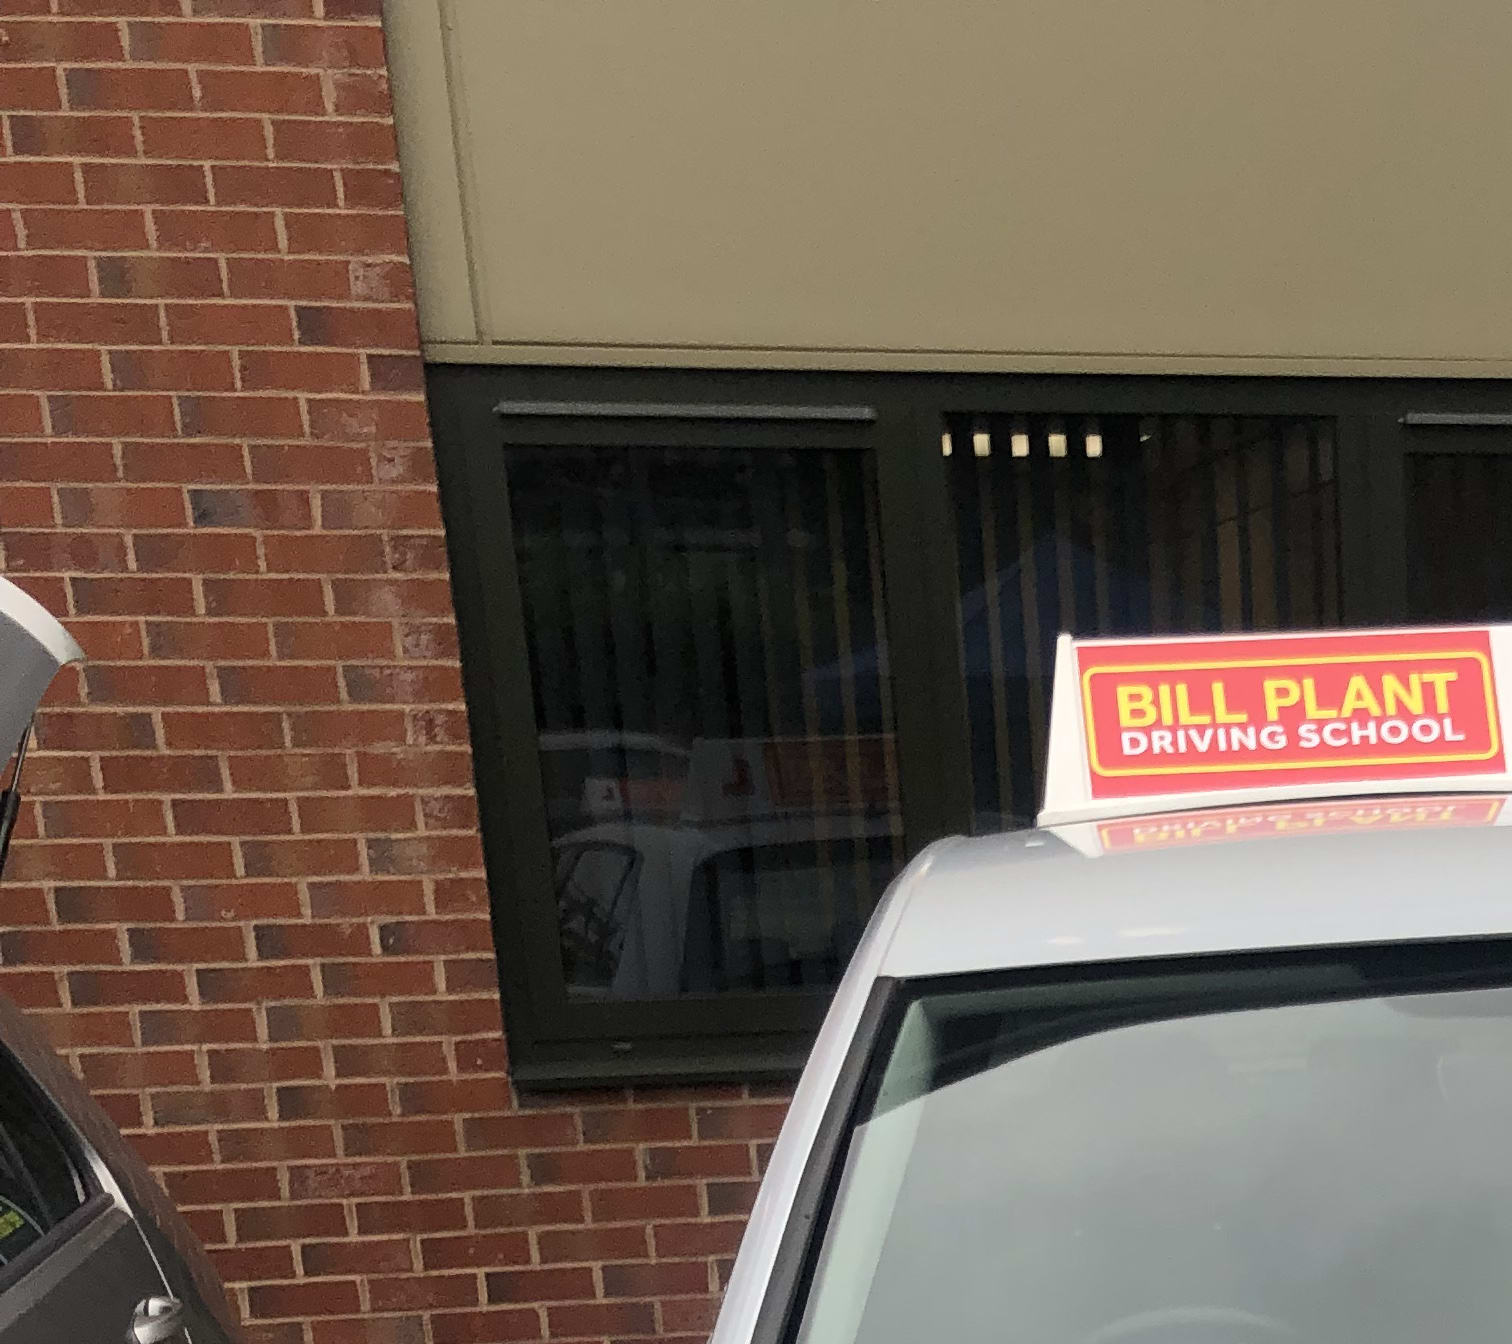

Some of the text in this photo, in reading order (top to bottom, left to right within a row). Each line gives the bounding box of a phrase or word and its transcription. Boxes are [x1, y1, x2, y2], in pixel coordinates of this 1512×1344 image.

[1116, 671, 1458, 728] BILL PLANT
[1120, 716, 1466, 756] DRIVING SCHOOL
